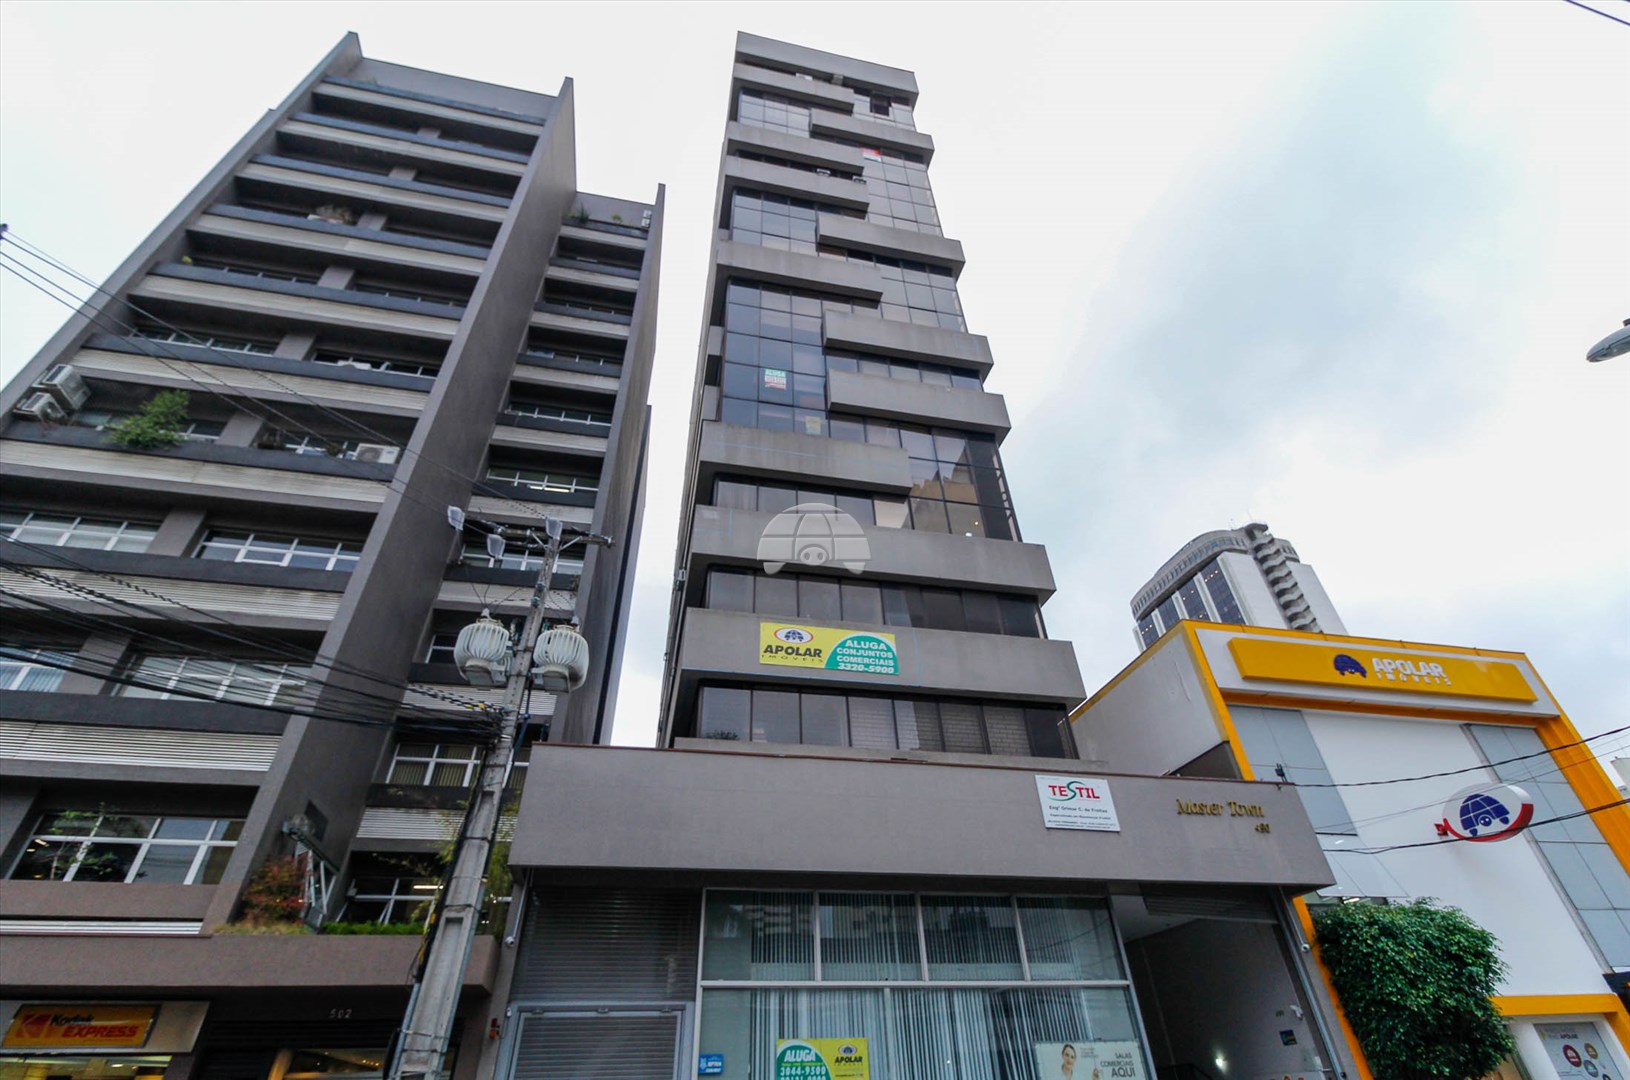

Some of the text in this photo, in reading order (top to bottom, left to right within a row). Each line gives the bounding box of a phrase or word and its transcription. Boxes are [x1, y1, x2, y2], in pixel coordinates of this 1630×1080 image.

[763, 644, 822, 658] APOLAR
[845, 639, 887, 651] ALUGA
[836, 647, 893, 658] CONJUNTOS
[836, 655, 894, 666] COMERCIAIS
[838, 662, 894, 673] 3320-5900
[1372, 657, 1447, 678] APOLAR
[1047, 781, 1100, 801] TESTIL
[1176, 799, 1265, 818] Master Town
[329, 1008, 352, 1018] 502
[50, 1013, 95, 1026] Kodak
[62, 1025, 139, 1038] EXPRESS
[784, 1050, 816, 1062] ALUGA
[834, 1056, 863, 1064] APOLAR
[780, 1066, 826, 1076] 3044-9500
[1111, 1067, 1136, 1077] AQUI
